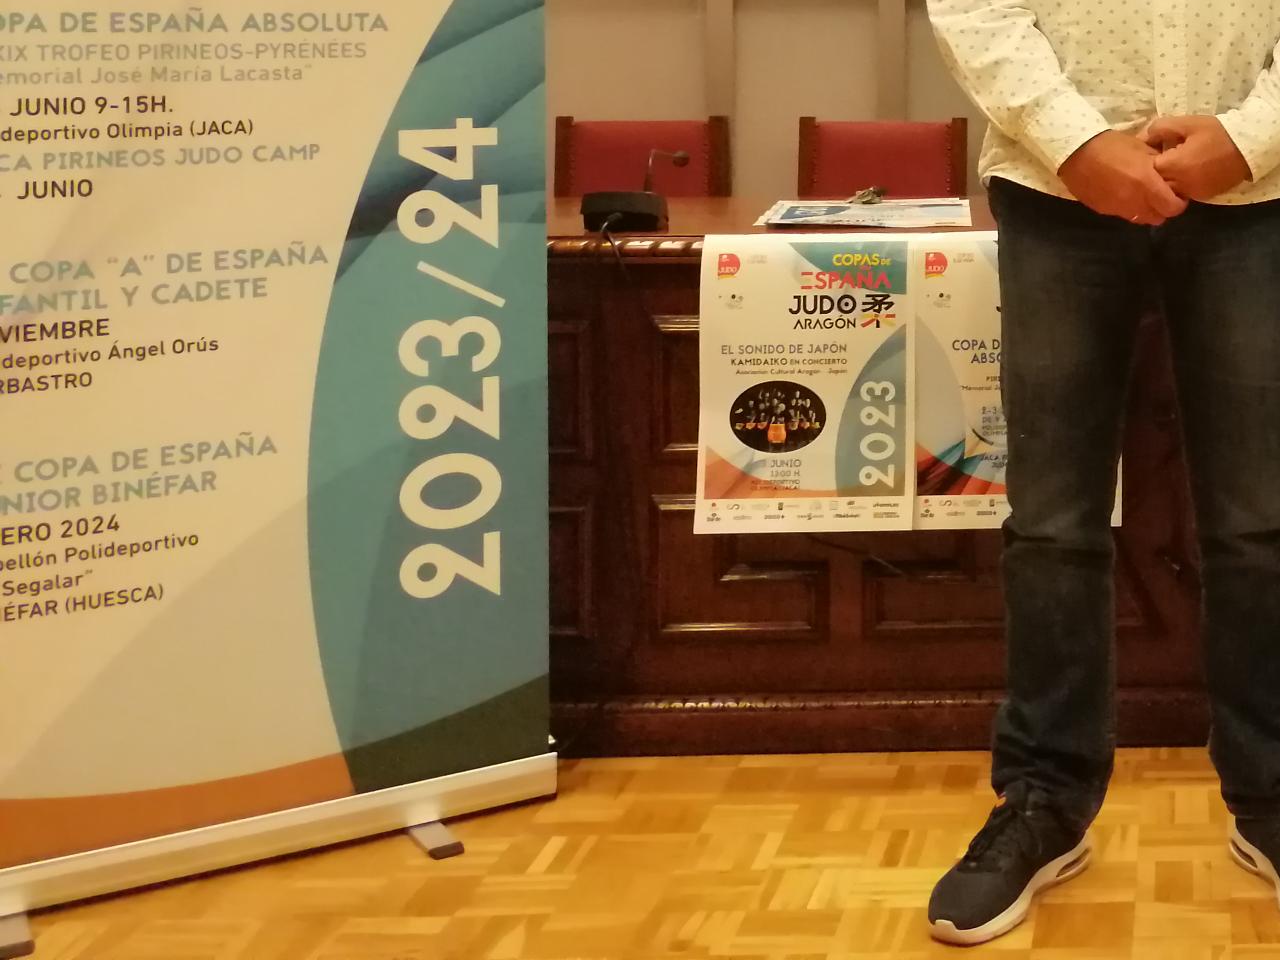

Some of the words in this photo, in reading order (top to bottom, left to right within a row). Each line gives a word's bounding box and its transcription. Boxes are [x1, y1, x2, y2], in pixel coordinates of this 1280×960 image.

[60, 12, 97, 33] DE
[110, 7, 228, 33] ESPAÑA
[241, 12, 388, 33] ABSOLUTA
[37, 43, 130, 61] TROFEO
[91, 67, 142, 84] José
[151, 65, 212, 83] María
[10, 97, 85, 117] JUNIO
[95, 96, 173, 115] 9-15H.
[1, 125, 100, 144] deportivo
[107, 122, 183, 140] Olimpia
[190, 120, 253, 137] (JACA)
[43, 149, 165, 170] PIRINEOS
[175, 147, 242, 165] JUDO
[253, 144, 320, 162] CAMP
[17, 179, 93, 200] JUNIO
[9, 260, 95, 284] COPA
[167, 253, 201, 274] DE
[214, 241, 328, 270] ESPAÑA
[833, 254, 880, 266] COPAS
[121, 286, 139, 306] Y
[152, 278, 268, 304] CADETE
[789, 295, 856, 314] JUDO
[794, 315, 856, 329] ARAGÓN
[2, 349, 100, 371] deportivo
[108, 341, 165, 362] Ángel
[172, 337, 219, 354] Orús
[722, 345, 735, 354] EL
[738, 344, 784, 354] SONIDO
[789, 344, 804, 354] DE
[808, 341, 847, 354] JAPÓN
[952, 340, 986, 350] COPA
[397, 117, 505, 599] 2023/24
[731, 358, 788, 366] KAMIDAIKO
[860, 381, 896, 488] 2023
[14, 457, 99, 483] COPA
[112, 448, 148, 472] DE
[160, 431, 278, 466] ESPAÑA
[93, 471, 217, 506] BINÉFAR
[61, 514, 119, 539] 2024
[65, 533, 199, 563] Polideportivo
[65, 584, 163, 614] (HUESCA)
